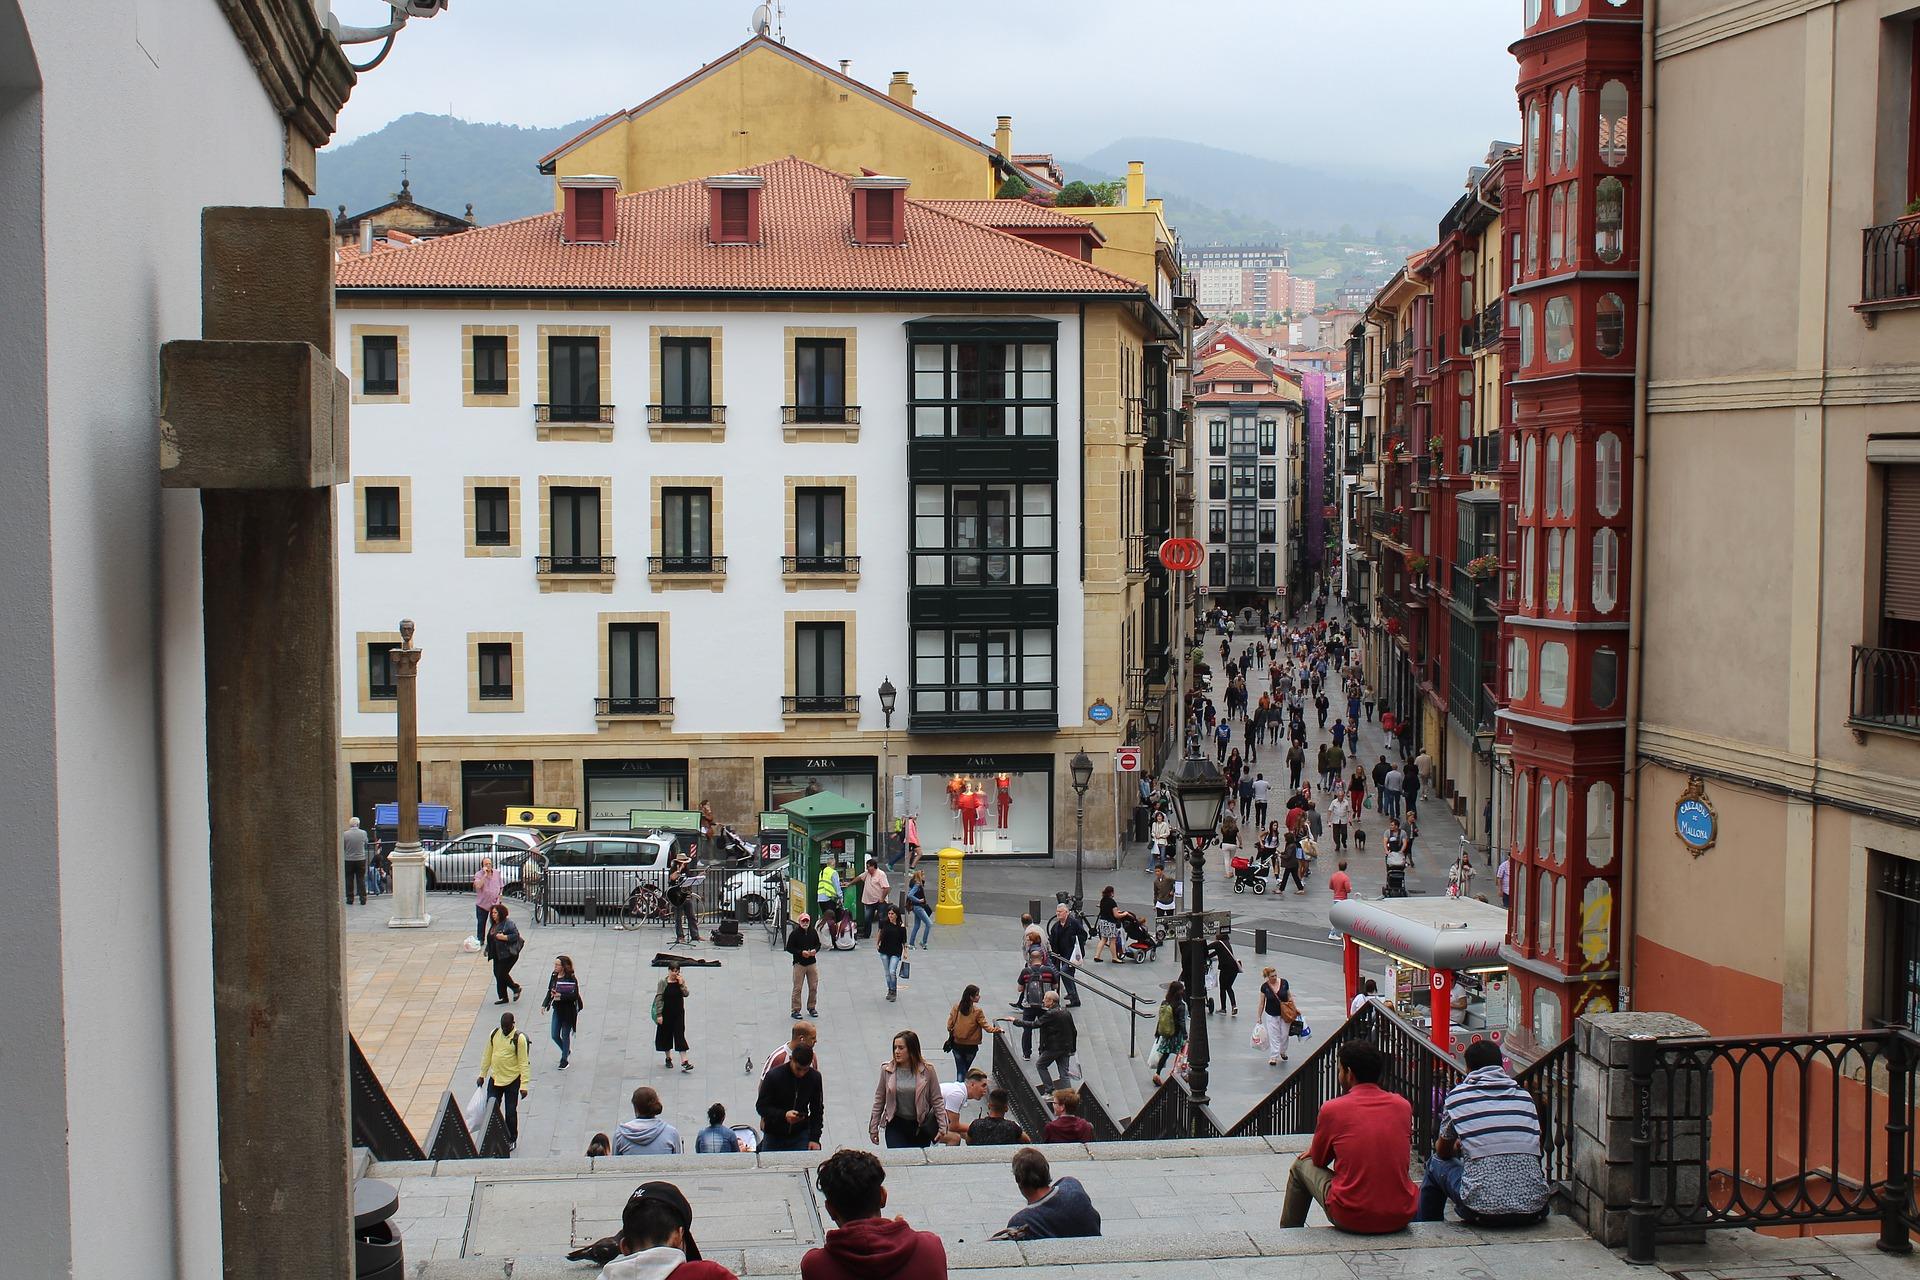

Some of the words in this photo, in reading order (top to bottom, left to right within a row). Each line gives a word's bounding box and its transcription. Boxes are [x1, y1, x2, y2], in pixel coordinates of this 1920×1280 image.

[806, 759, 836, 768] ZARA
[967, 757, 995, 765] ZARA
[372, 764, 395, 773] ZAR
[484, 763, 513, 771] ZARA
[622, 762, 651, 770] ZARA
[1680, 801, 1710, 818] CALZADAS
[1681, 820, 1708, 839] MALLONA
[1460, 940, 1501, 959] Helad
[1435, 976, 1442, 986] B
